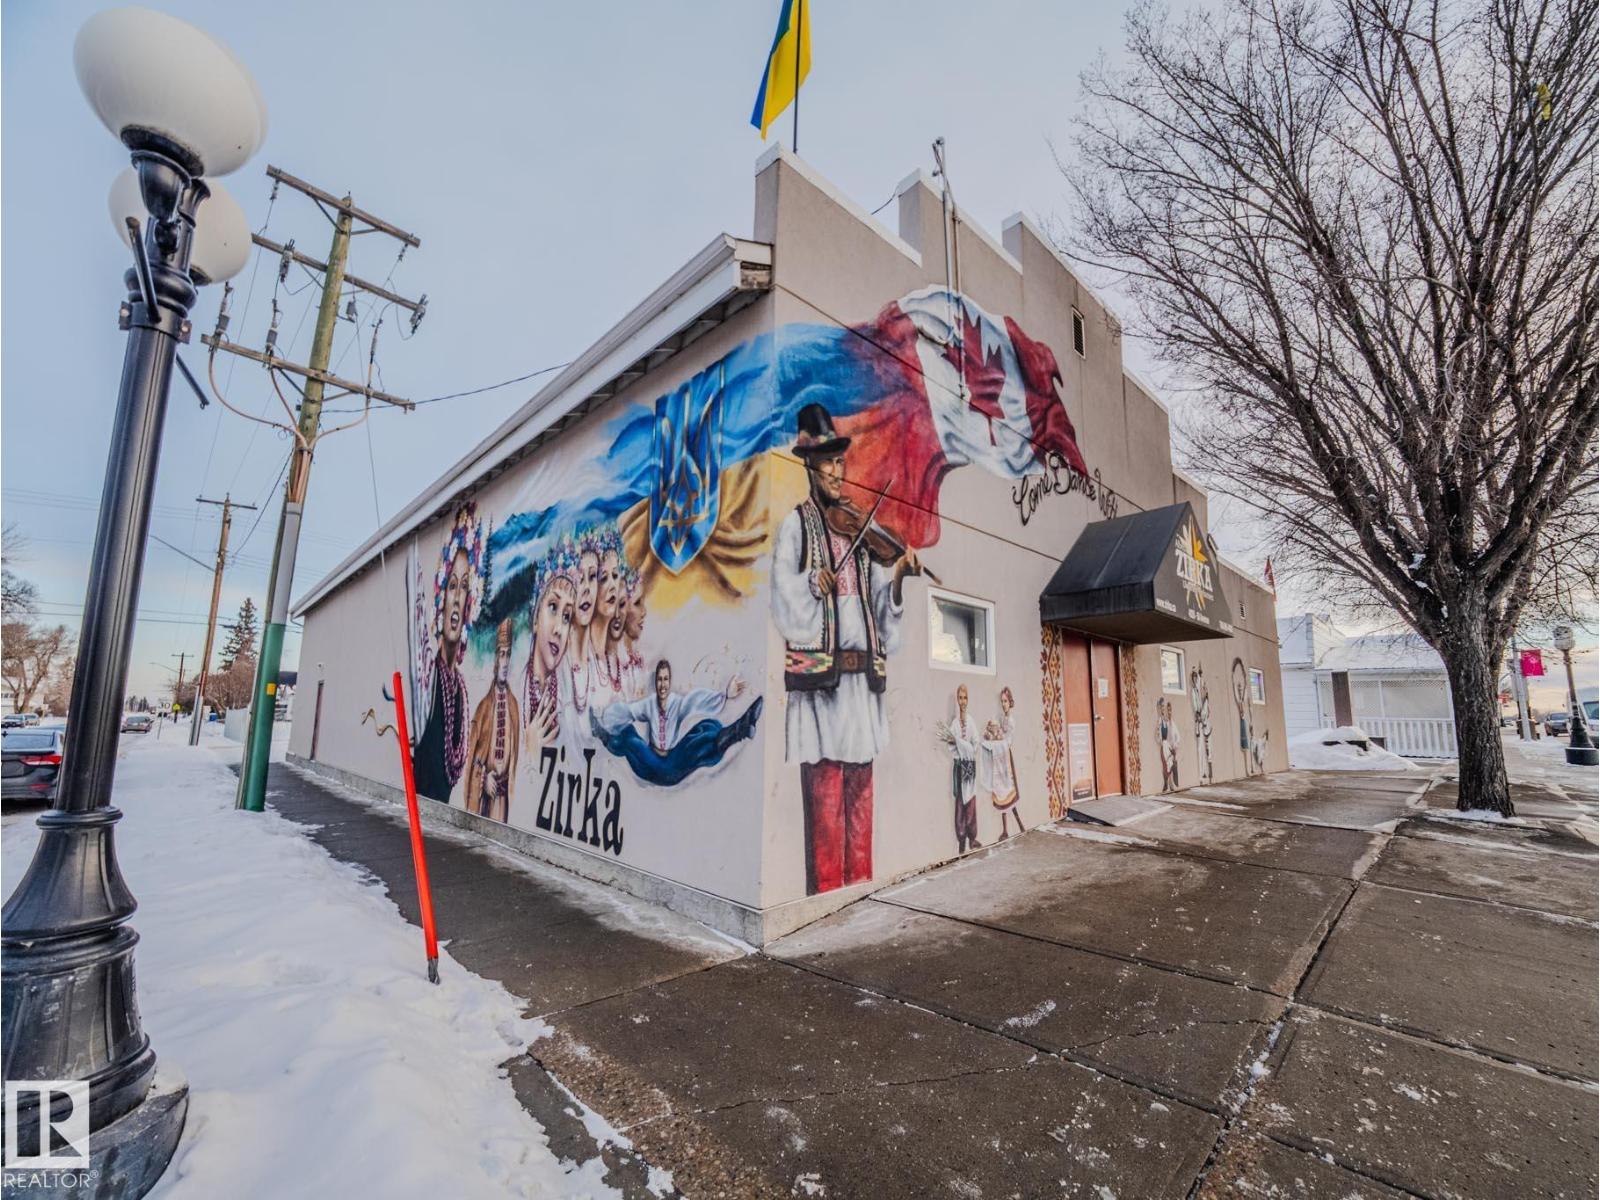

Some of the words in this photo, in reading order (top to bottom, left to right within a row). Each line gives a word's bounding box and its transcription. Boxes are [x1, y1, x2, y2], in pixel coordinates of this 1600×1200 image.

[1011, 473, 1053, 526] Come
[1049, 450, 1096, 501] Dance
[1175, 548, 1213, 592] ZIRKA
[536, 745, 624, 856] Zirka
